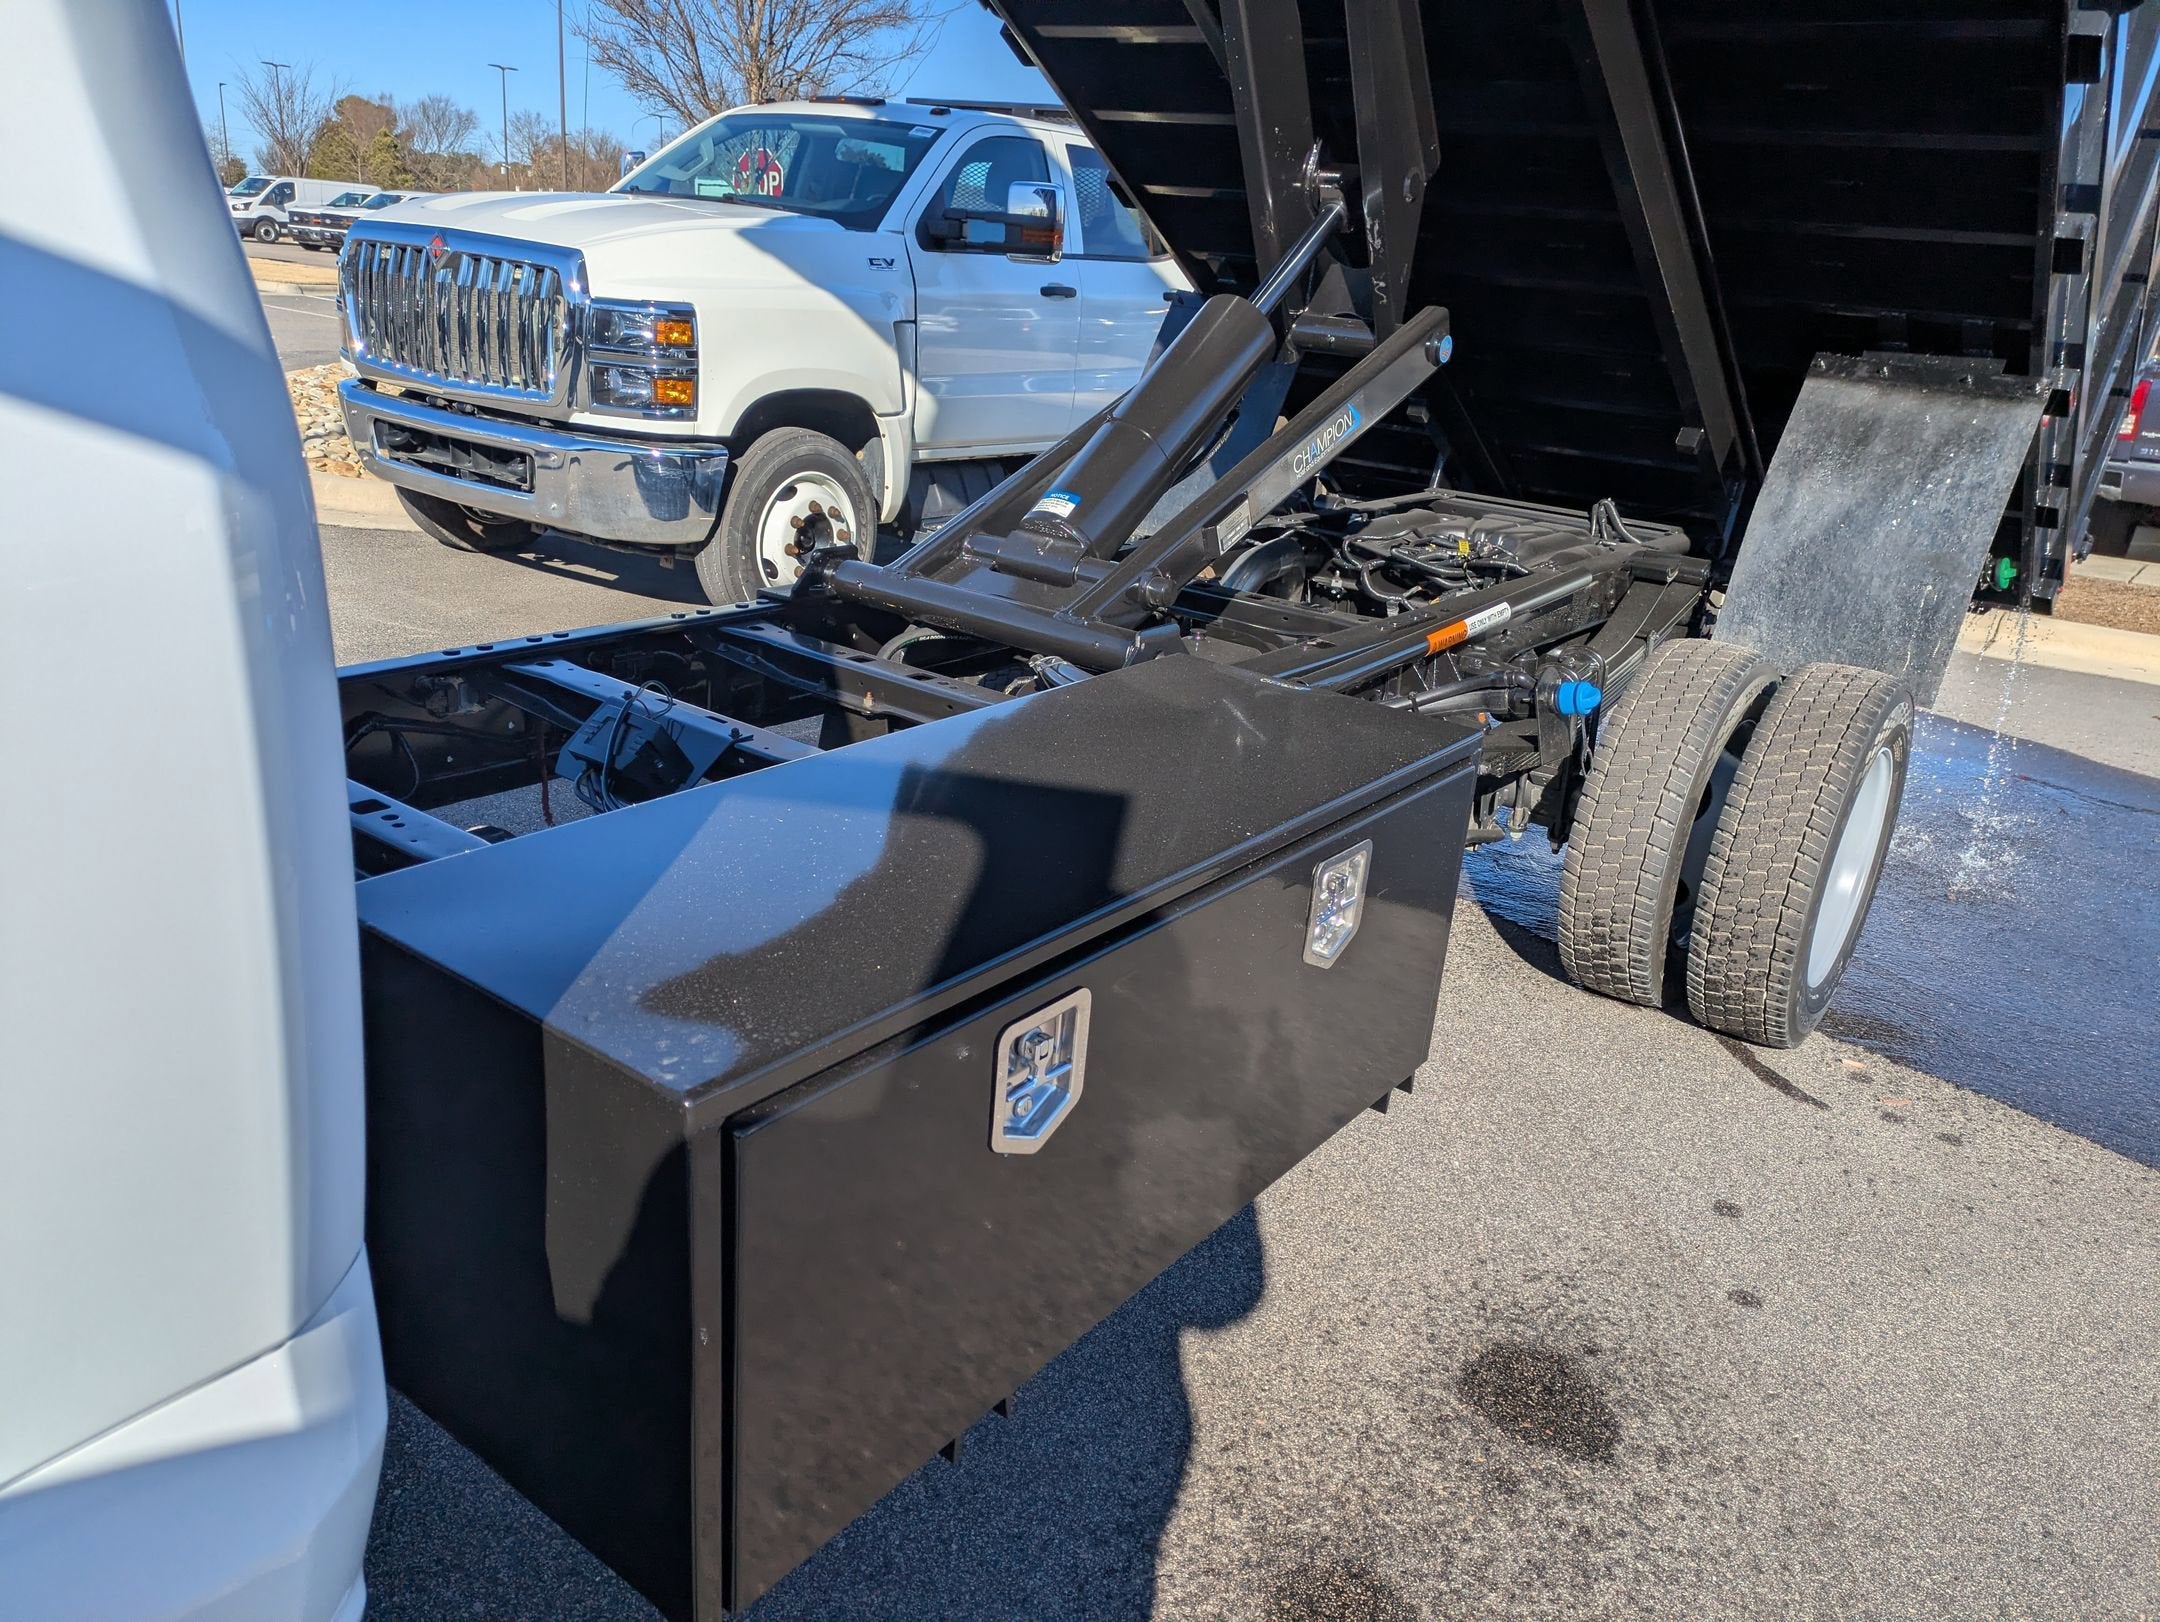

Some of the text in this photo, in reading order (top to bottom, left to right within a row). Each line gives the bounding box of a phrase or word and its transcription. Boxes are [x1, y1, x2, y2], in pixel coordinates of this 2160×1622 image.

[868, 257, 896, 267] CV
[1293, 410, 1353, 474] CHAMPION
[1050, 493, 1071, 501] NOTICE
[1469, 621, 1477, 631] USE
[1477, 617, 1487, 627] ONLY
[1438, 629, 1467, 647] WARNING
